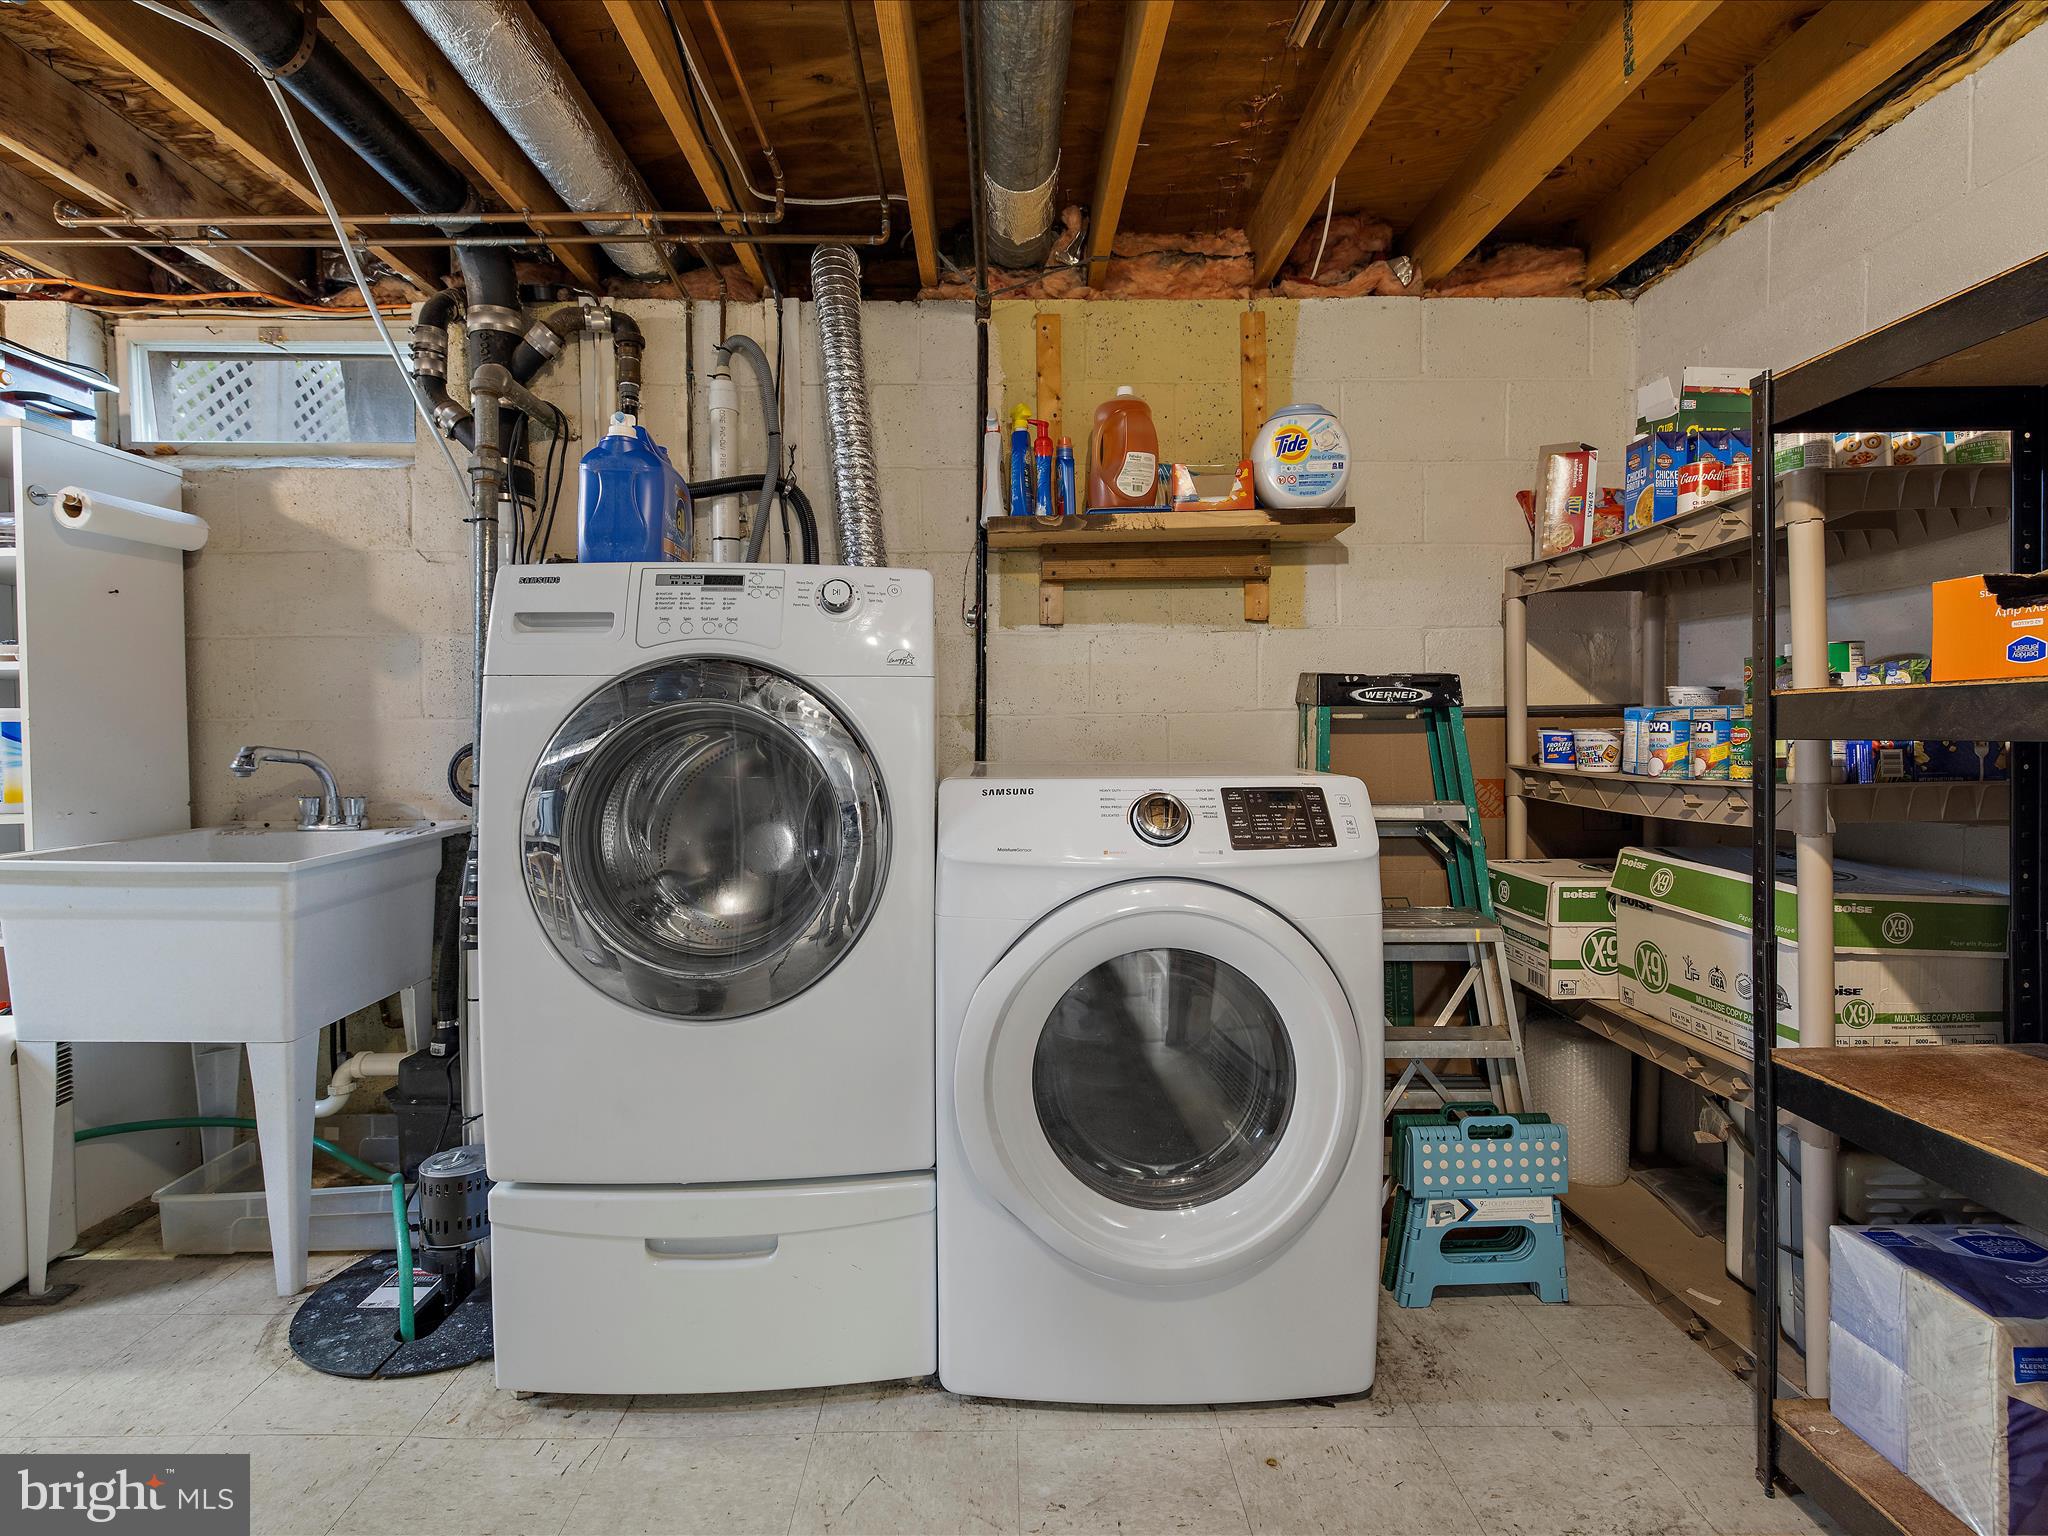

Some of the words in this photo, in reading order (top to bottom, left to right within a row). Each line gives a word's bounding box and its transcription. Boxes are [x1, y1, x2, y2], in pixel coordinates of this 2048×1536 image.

[1275, 434, 1308, 458] Tide
[1627, 467, 1647, 483] CHICKEN
[1656, 470, 1678, 480] CHICKE
[1656, 480, 1674, 488] BROTH
[1569, 496, 1582, 514] RITZ
[518, 576, 561, 584] SAMSUNG
[1365, 691, 1417, 699] WERNER
[1650, 722, 1669, 732] OYA
[1546, 741, 1573, 749] FROSTED
[981, 788, 1035, 797] SAMSUNG
[1621, 858, 1647, 871] BOISE
[1563, 889, 1597, 899] BOISE
[1834, 903, 1873, 914] BOISE
[1738, 913, 1753, 924] Pape
[1710, 977, 1725, 990] USA
[1834, 985, 1861, 996] OISE
[1695, 995, 1725, 1013] MULTI-USE
[1725, 1006, 1743, 1021] COPY
[1894, 1015, 1931, 1023] MULTI-USE
[1952, 1013, 1975, 1021] PAPER
